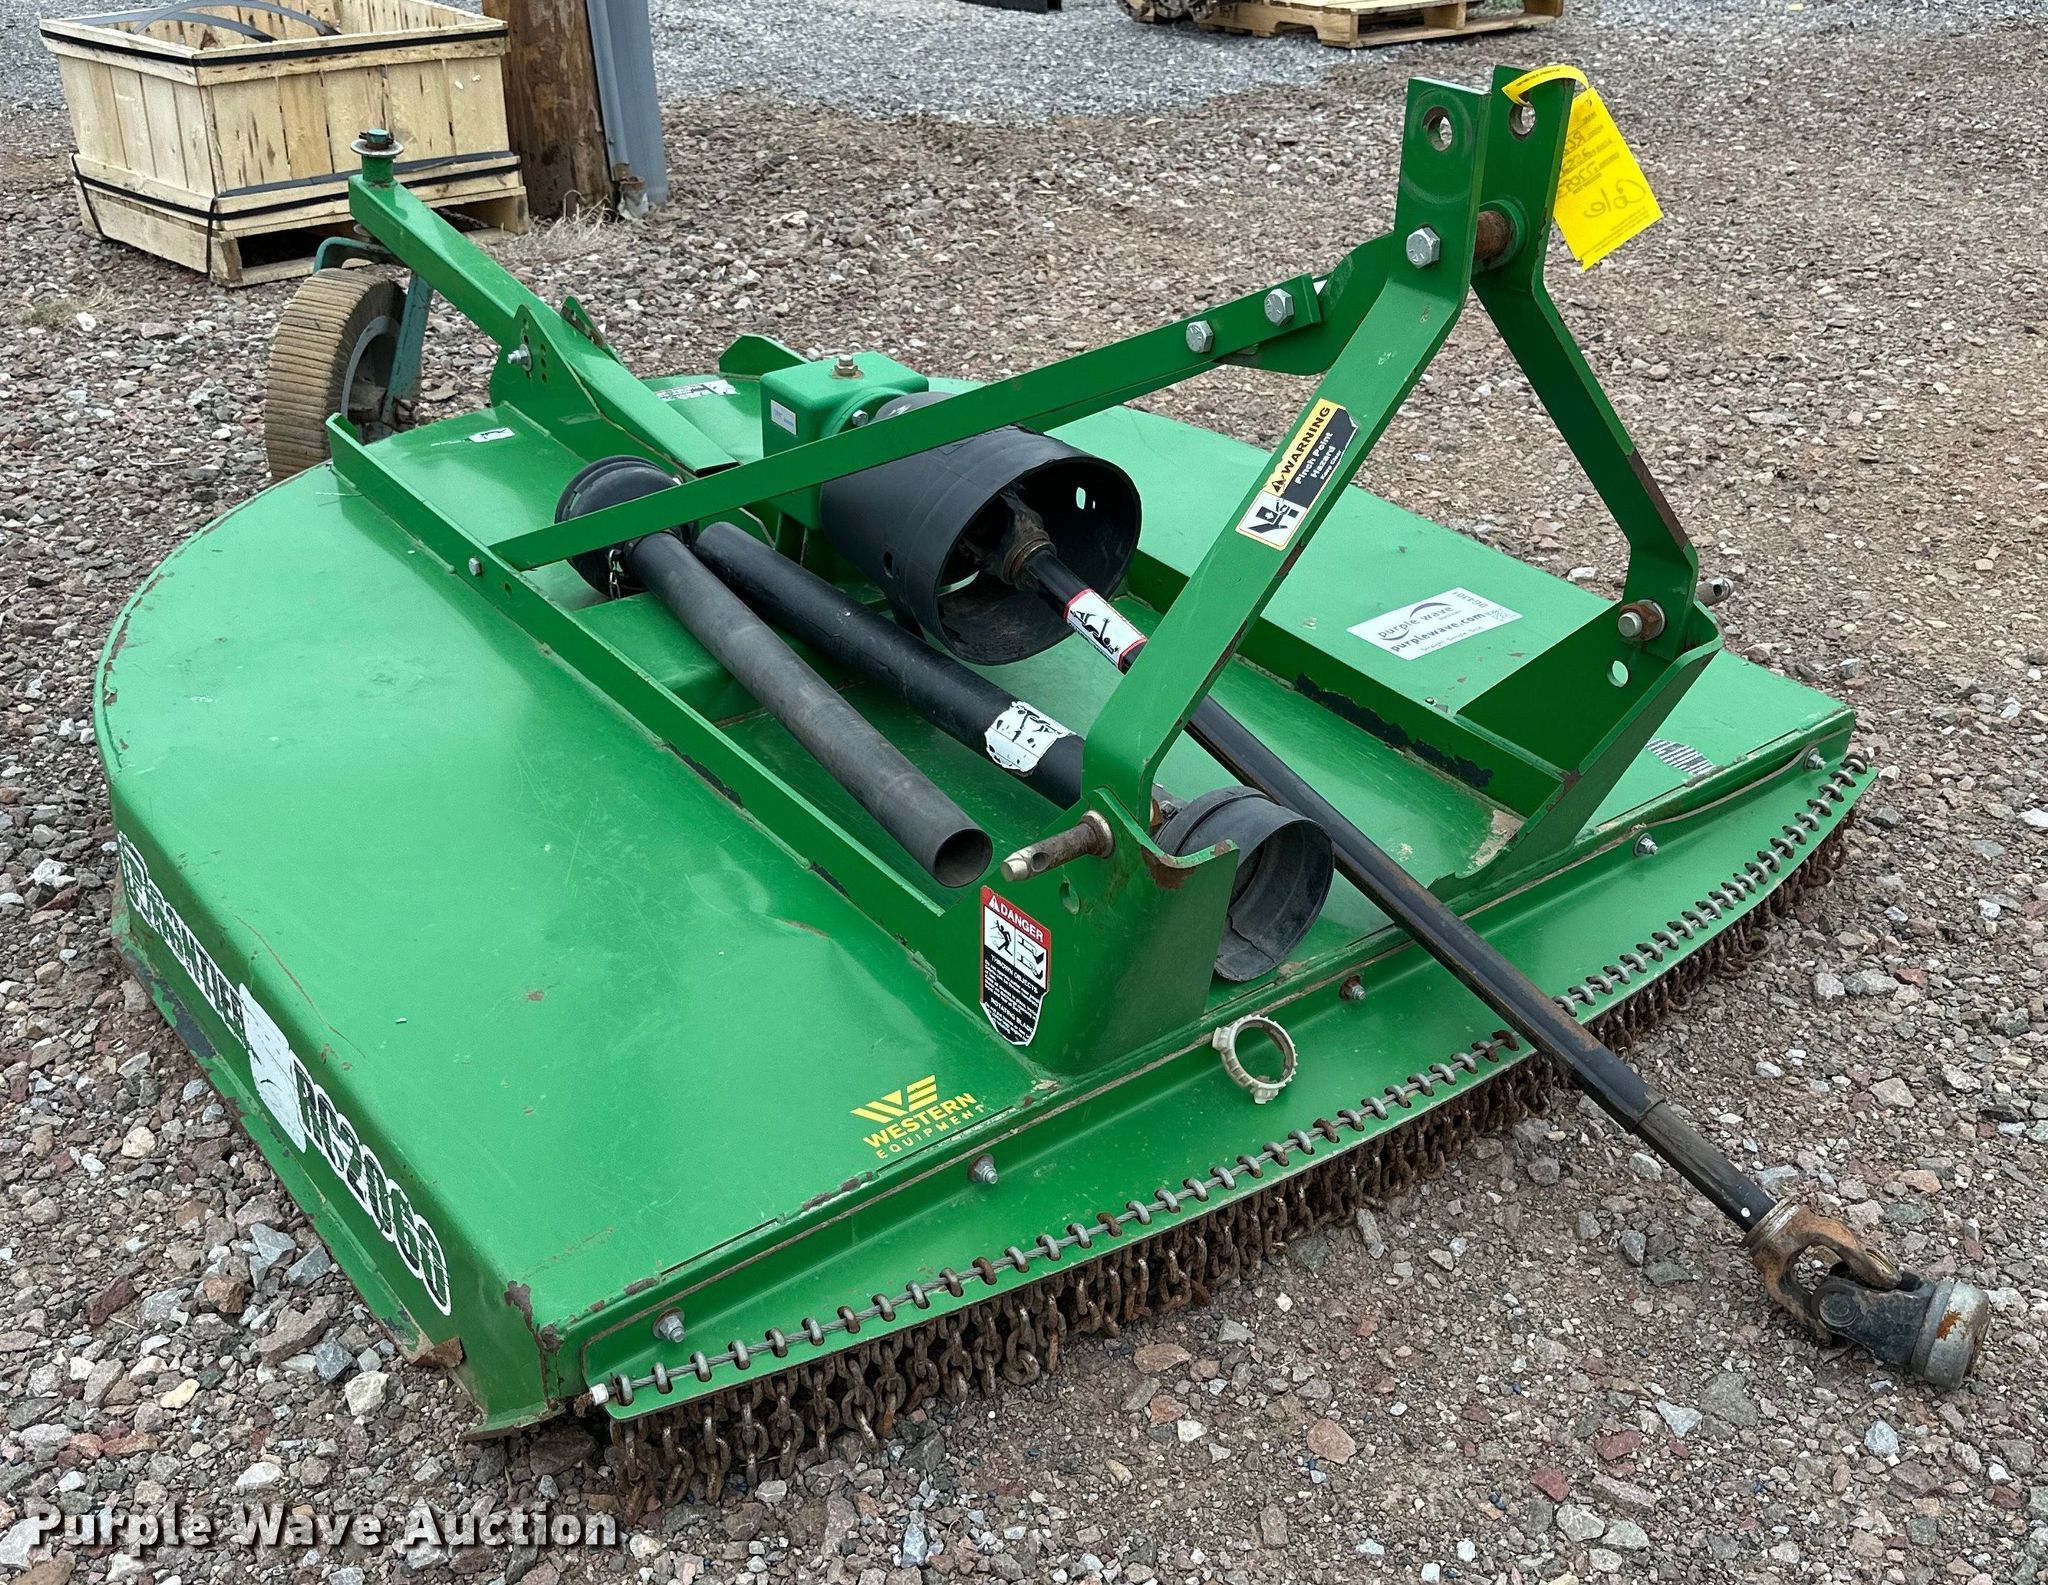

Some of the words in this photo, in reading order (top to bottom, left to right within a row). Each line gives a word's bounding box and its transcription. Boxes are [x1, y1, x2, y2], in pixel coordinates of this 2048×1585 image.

[1281, 407, 1330, 474] WARNING
[1294, 458, 1316, 484] Pinch
[1312, 432, 1333, 457] Point
[1310, 445, 1336, 478] Hazard
[1377, 618, 1420, 638] purple
[1420, 606, 1454, 621] wave
[1390, 613, 1486, 652] purplewave.com
[1000, 902, 1044, 943] DANGER
[862, 1093, 977, 1148] WESTERN
[876, 1103, 985, 1159] EQUIPMENT
[289, 1049, 452, 1317] RC2060
